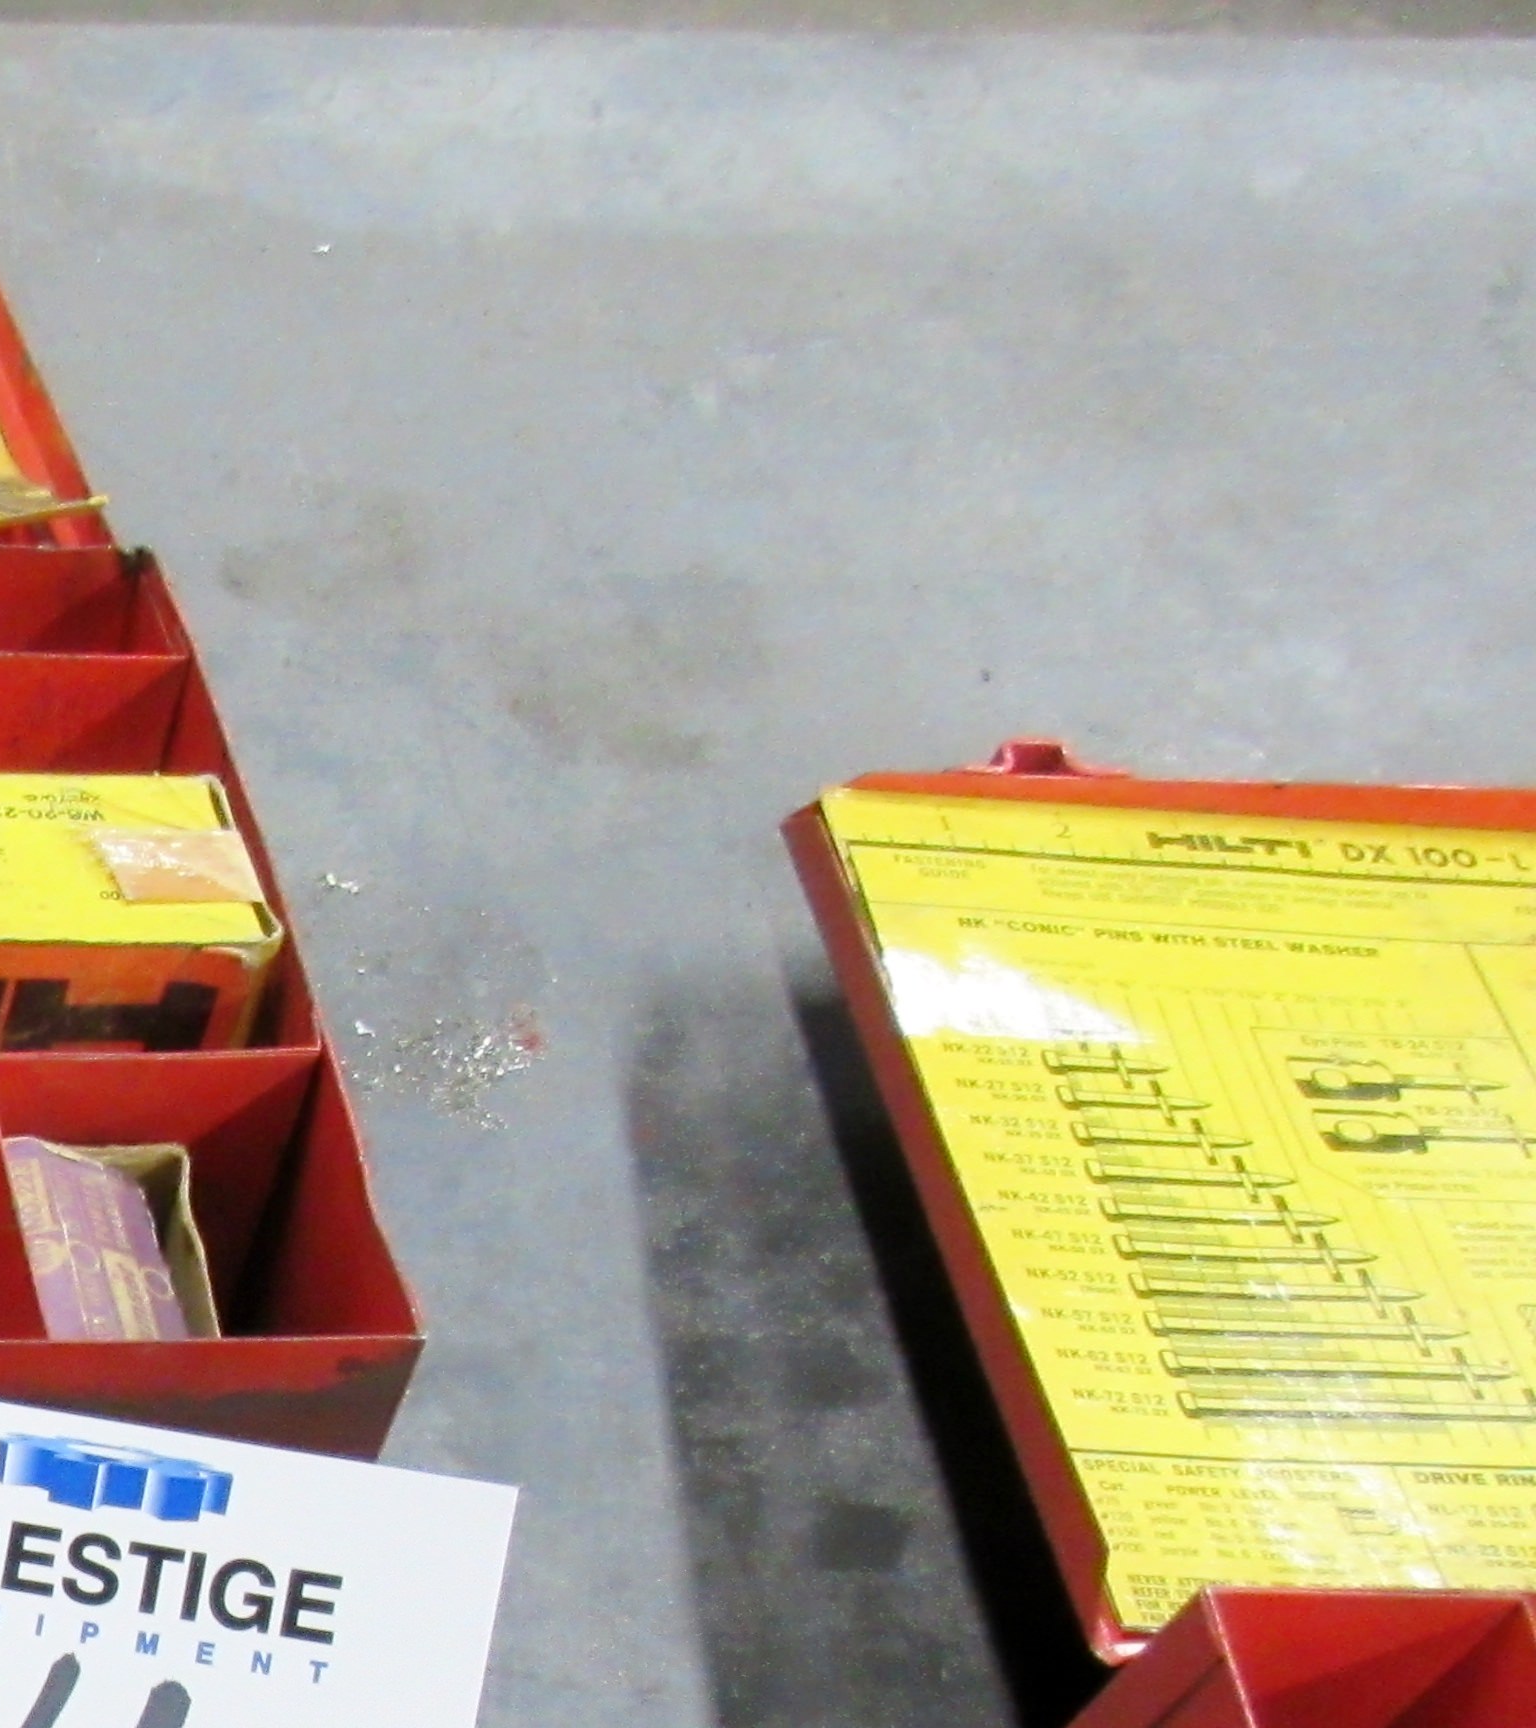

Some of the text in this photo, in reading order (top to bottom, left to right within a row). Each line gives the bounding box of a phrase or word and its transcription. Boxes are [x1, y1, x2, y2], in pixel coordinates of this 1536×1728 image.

[1145, 830, 1314, 859] HILTI
[1339, 842, 1394, 865] DX
[893, 853, 986, 869] FASTENING
[918, 867, 971, 880] GUIDE
[957, 916, 986, 930] NK
[1093, 927, 1144, 943] PINS
[1151, 932, 1206, 946] WITH
[1213, 935, 1279, 952] STEEL
[1286, 940, 1381, 958] WASHER
[998, 1045, 1029, 1058] S12
[1010, 1081, 1043, 1093] S12
[1025, 1117, 1059, 1130] S12
[1038, 1154, 1072, 1167] S12
[1057, 1192, 1088, 1206] S12
[1067, 1231, 1102, 1245] S12
[1086, 1271, 1118, 1284] S12
[1100, 1311, 1133, 1324] S12
[1116, 1351, 1148, 1365] S12
[1131, 1392, 1165, 1406] S12
[1082, 1457, 1160, 1475] SPECIAL
[1171, 1463, 1241, 1480] SAFETY
[1414, 1471, 1487, 1486] DRIVE
[1165, 1485, 1221, 1497] POWER
